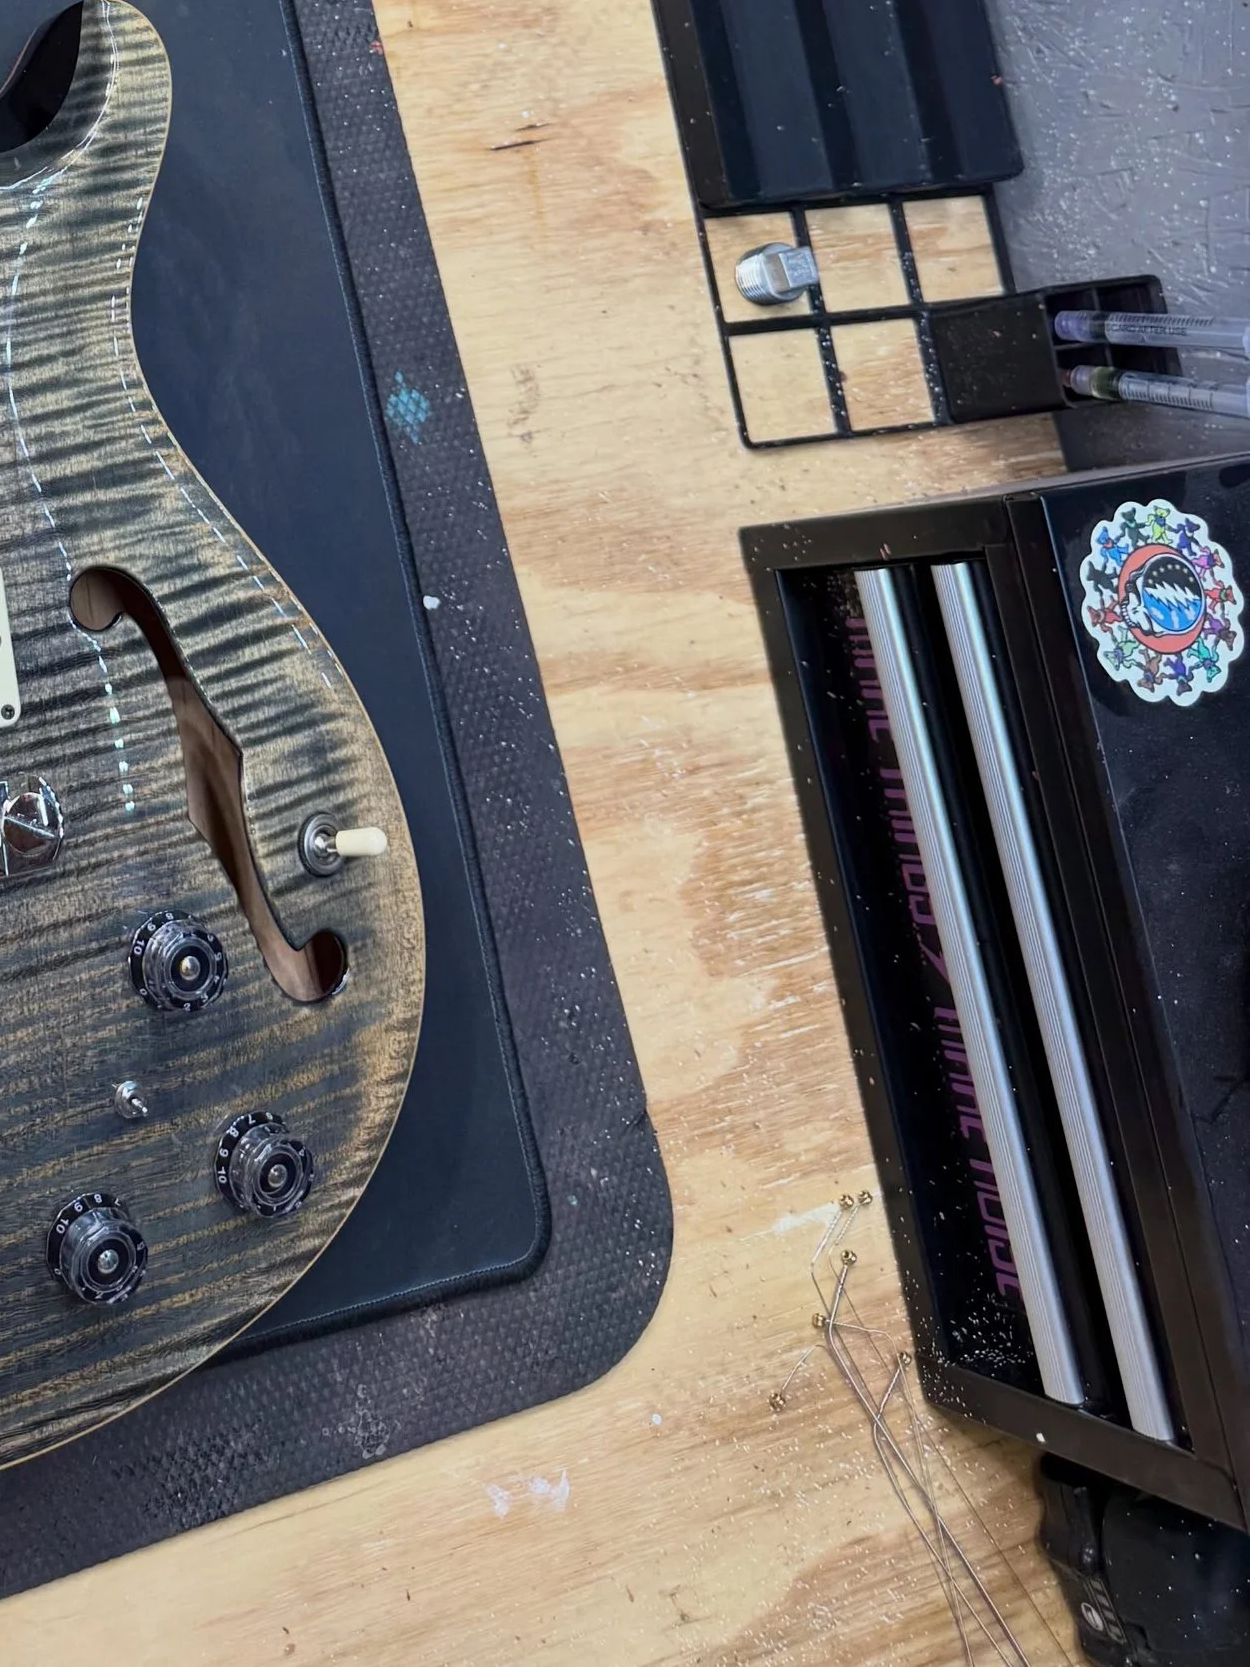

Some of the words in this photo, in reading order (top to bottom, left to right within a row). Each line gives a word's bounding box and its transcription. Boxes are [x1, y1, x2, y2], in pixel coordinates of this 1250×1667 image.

[134, 939, 144, 955] 10
[217, 1166, 227, 1184] 10
[56, 1219, 69, 1234] 10
